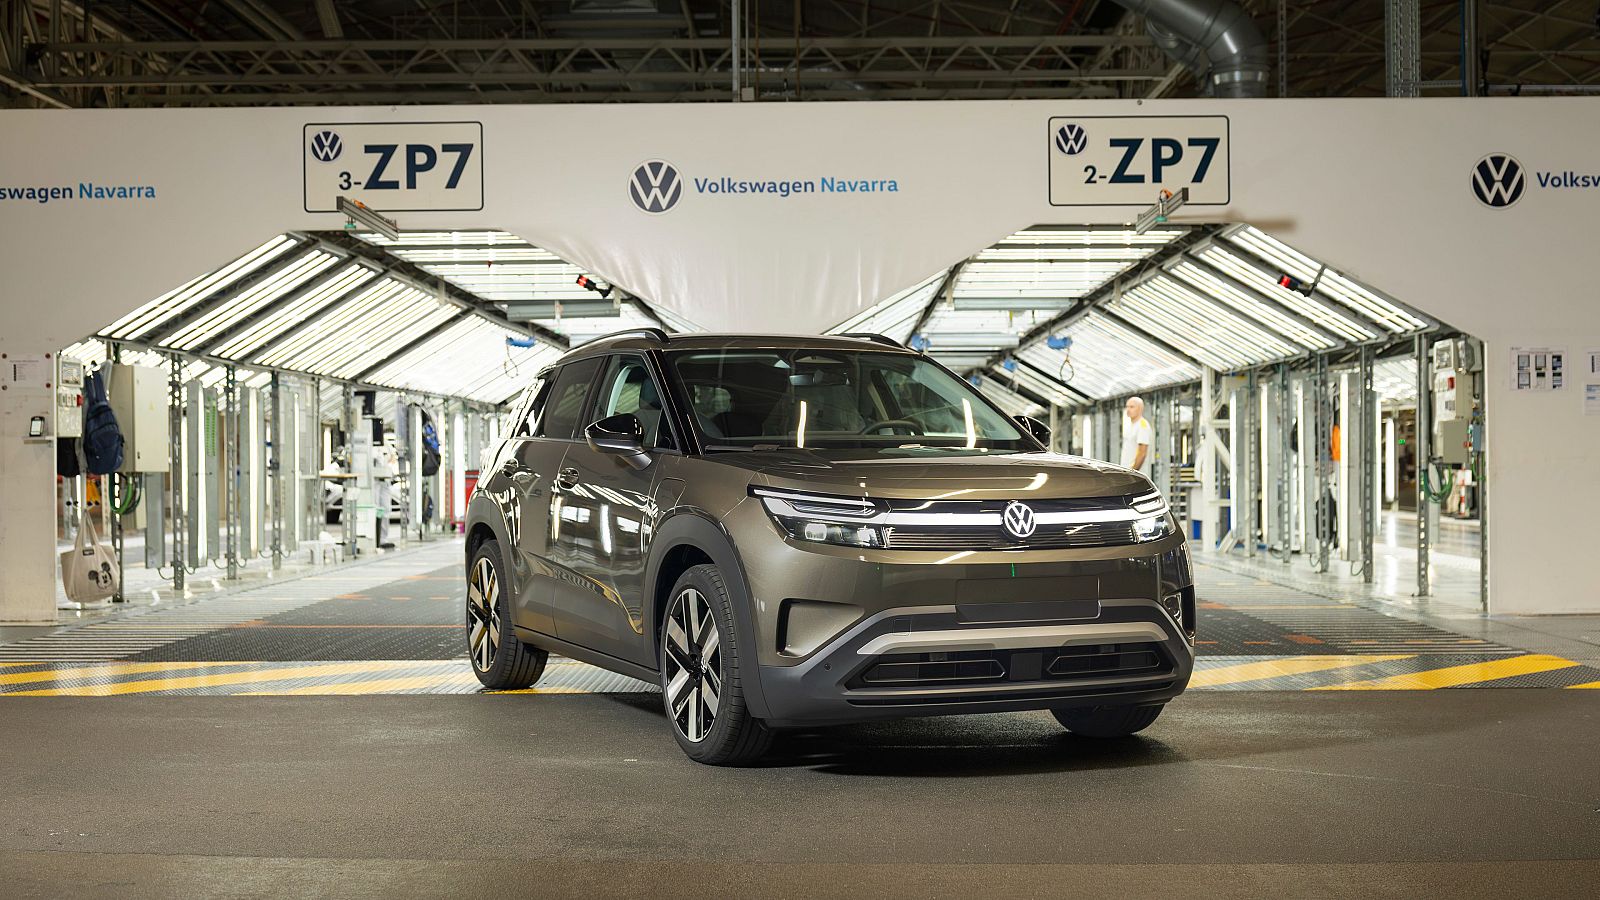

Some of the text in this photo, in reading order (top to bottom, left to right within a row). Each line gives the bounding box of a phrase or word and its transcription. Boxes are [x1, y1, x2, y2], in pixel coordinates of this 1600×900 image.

[338, 143, 474, 190] 3-ZP7
[1083, 137, 1221, 184] 2-ZP7
[79, 183, 156, 199] Navarra
[694, 177, 815, 198] Volkswagen
[821, 177, 899, 193] Navarra
